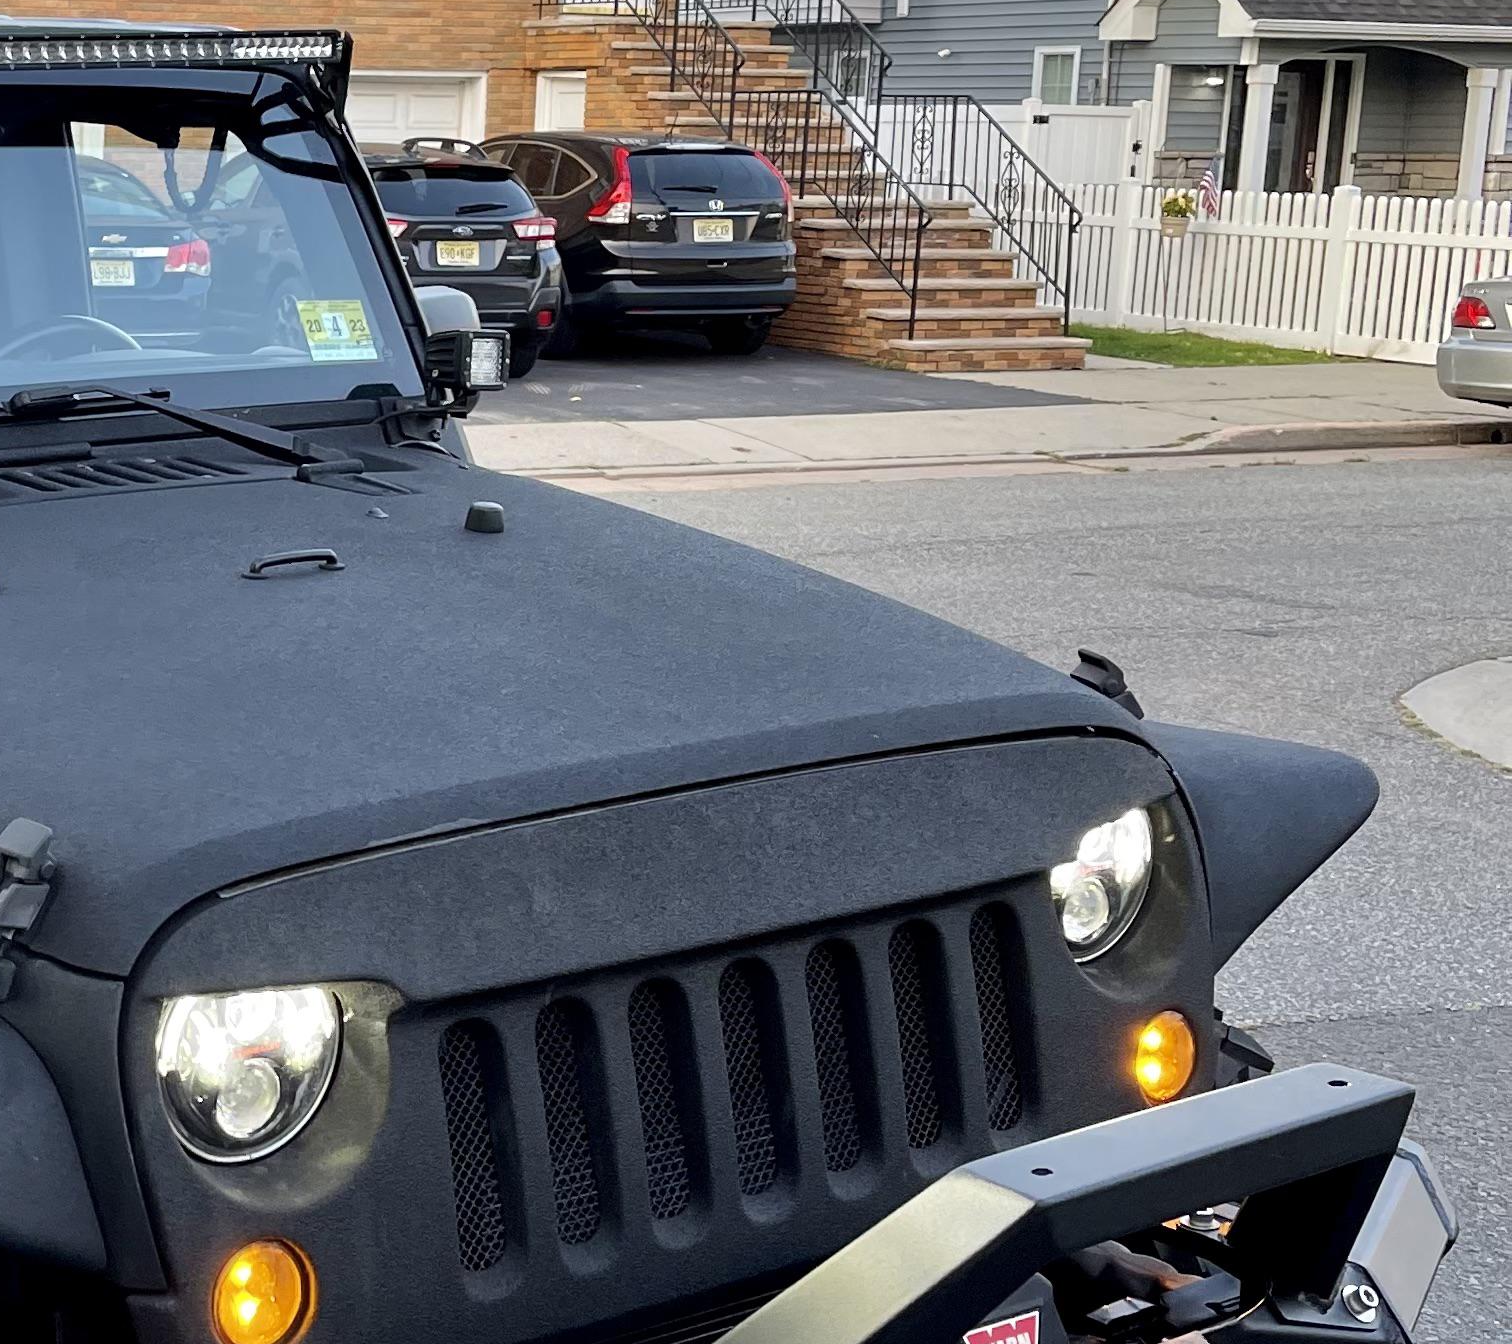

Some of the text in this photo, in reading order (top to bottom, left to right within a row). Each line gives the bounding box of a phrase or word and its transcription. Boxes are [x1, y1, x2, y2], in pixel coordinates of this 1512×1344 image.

[306, 316, 366, 337] 20 4 23
